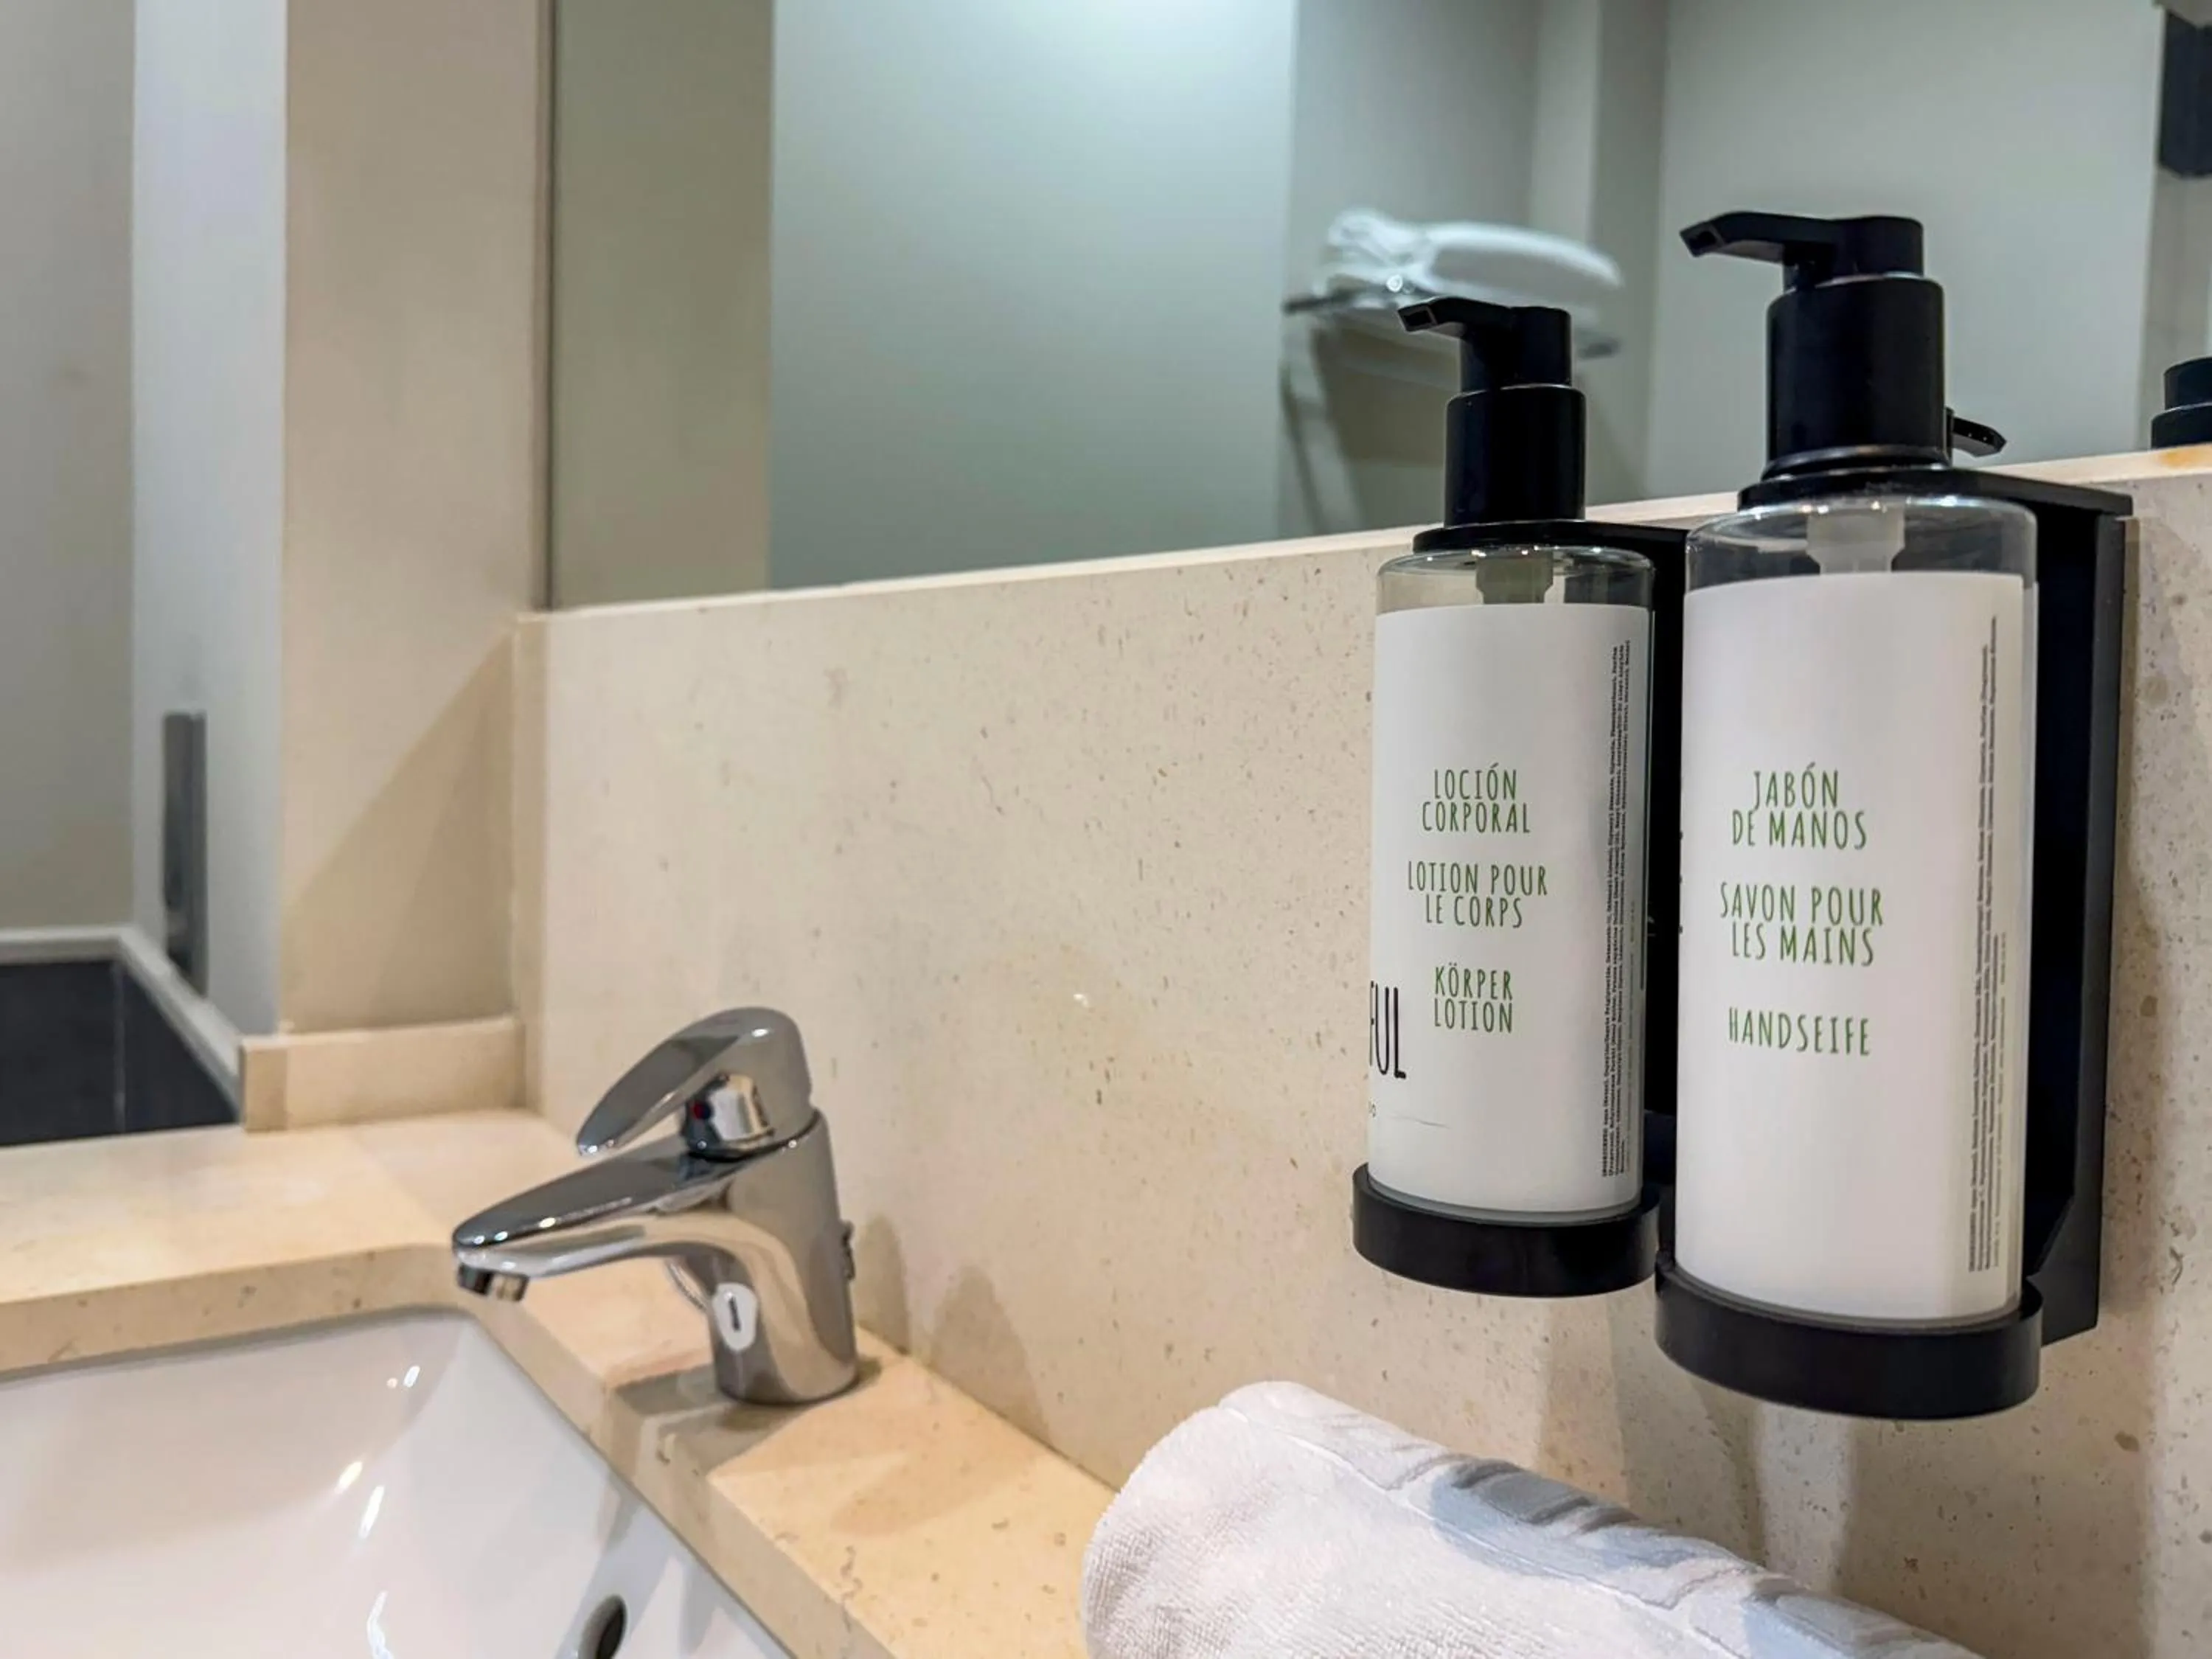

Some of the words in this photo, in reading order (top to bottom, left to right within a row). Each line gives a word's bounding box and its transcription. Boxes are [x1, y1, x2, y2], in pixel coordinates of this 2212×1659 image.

[1434, 762, 1517, 801] LOCIÓN
[1752, 762, 1839, 811] JABÓN
[1422, 801, 1531, 834] CORPORAL
[1732, 809, 1756, 847] DE
[1769, 810, 1867, 851] MANOS
[1408, 860, 1479, 894] LOTION
[1490, 863, 1548, 897] POUR
[1425, 894, 1444, 925] LE
[1453, 894, 1523, 929] CORPS
[1720, 881, 1795, 923] SAVON
[1810, 886, 1884, 927] POUR
[1732, 921, 1766, 961] LES
[1779, 922, 1876, 967] MAINS
[1434, 961, 1513, 1001] KÖRPER
[1434, 998, 1513, 1034] LOTION
[1728, 1006, 1870, 1057] HANDSEIFE
